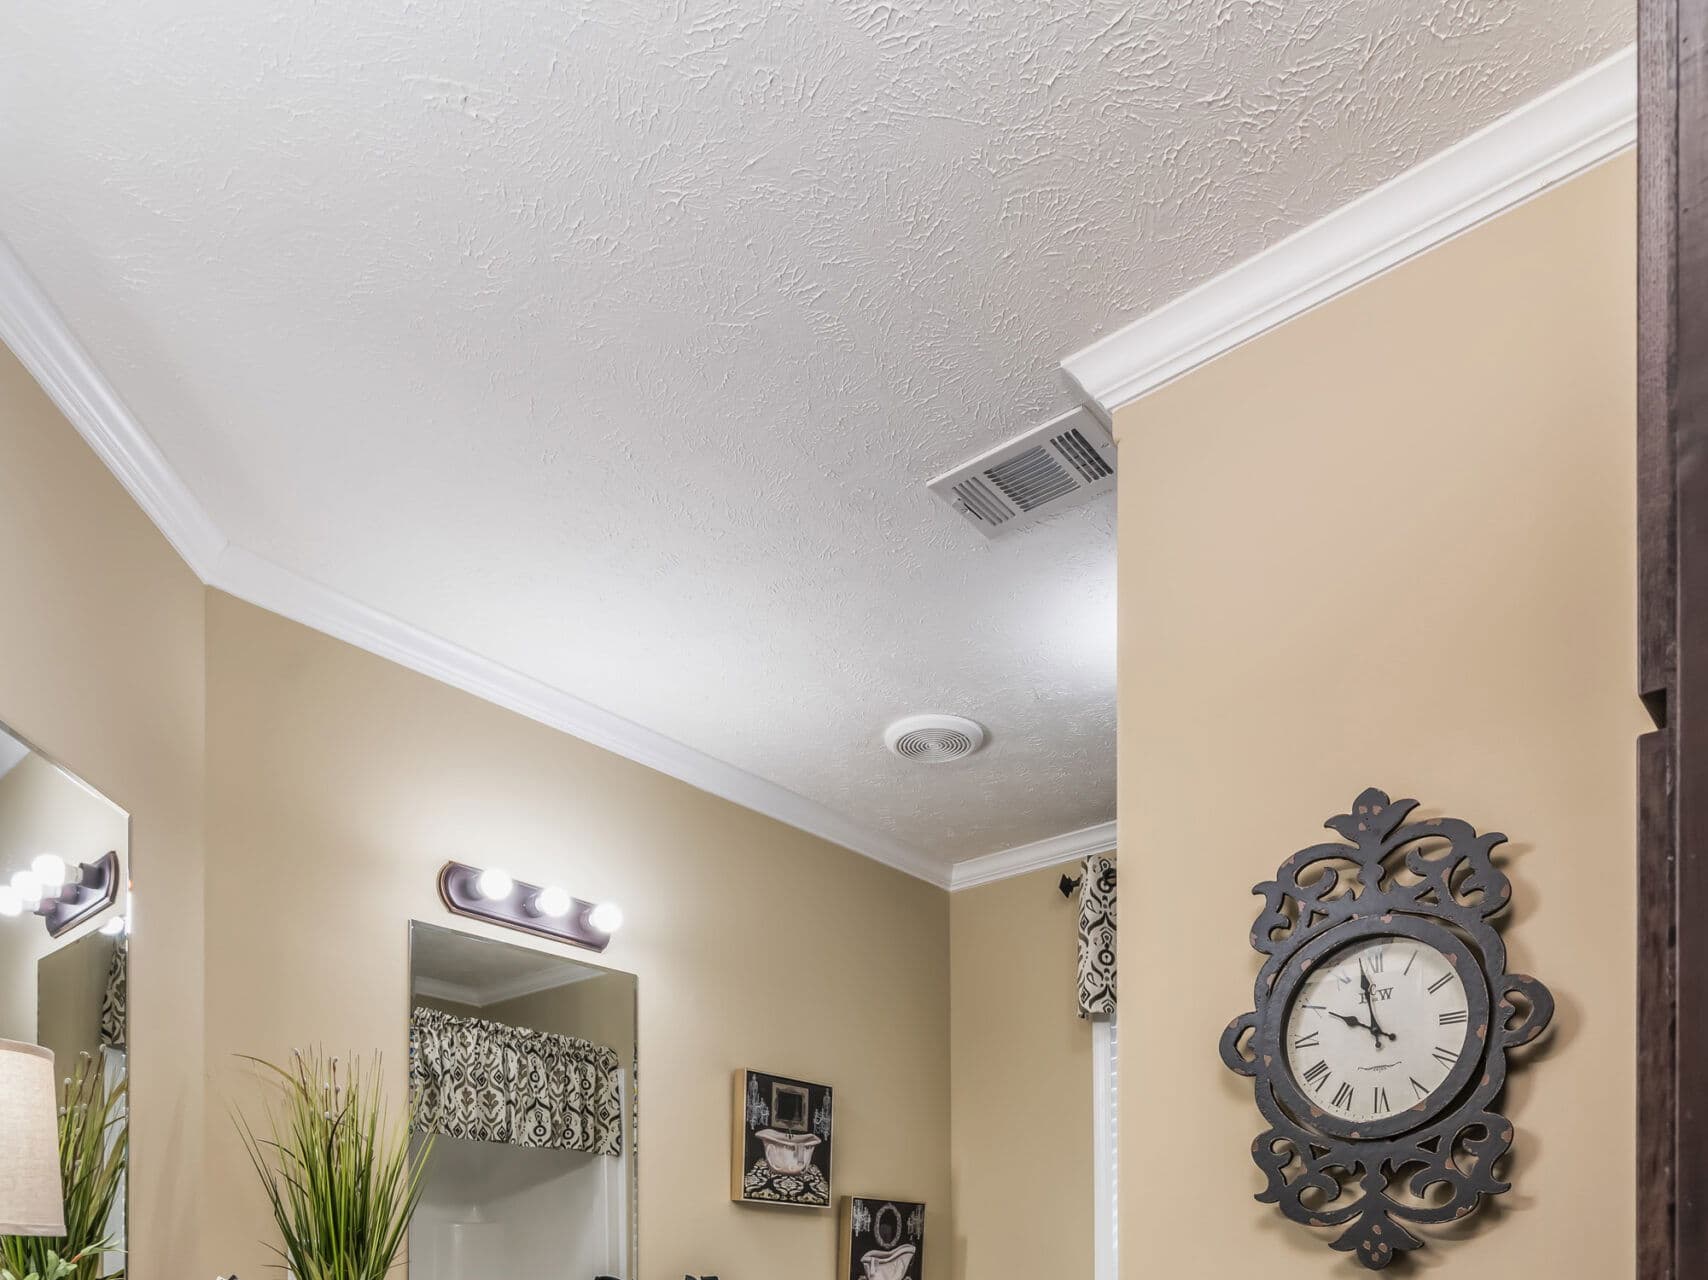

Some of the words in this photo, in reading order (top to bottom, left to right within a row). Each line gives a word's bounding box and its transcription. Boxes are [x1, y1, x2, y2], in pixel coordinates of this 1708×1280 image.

[1427, 972, 1454, 994] II
[1439, 1010, 1467, 1025] III
[1432, 1046, 1459, 1069] IV
[1303, 1060, 1332, 1092] VIII
[1409, 1076, 1430, 1100] V
[1331, 1082, 1354, 1111] VII
[1374, 1087, 1390, 1113] VI
